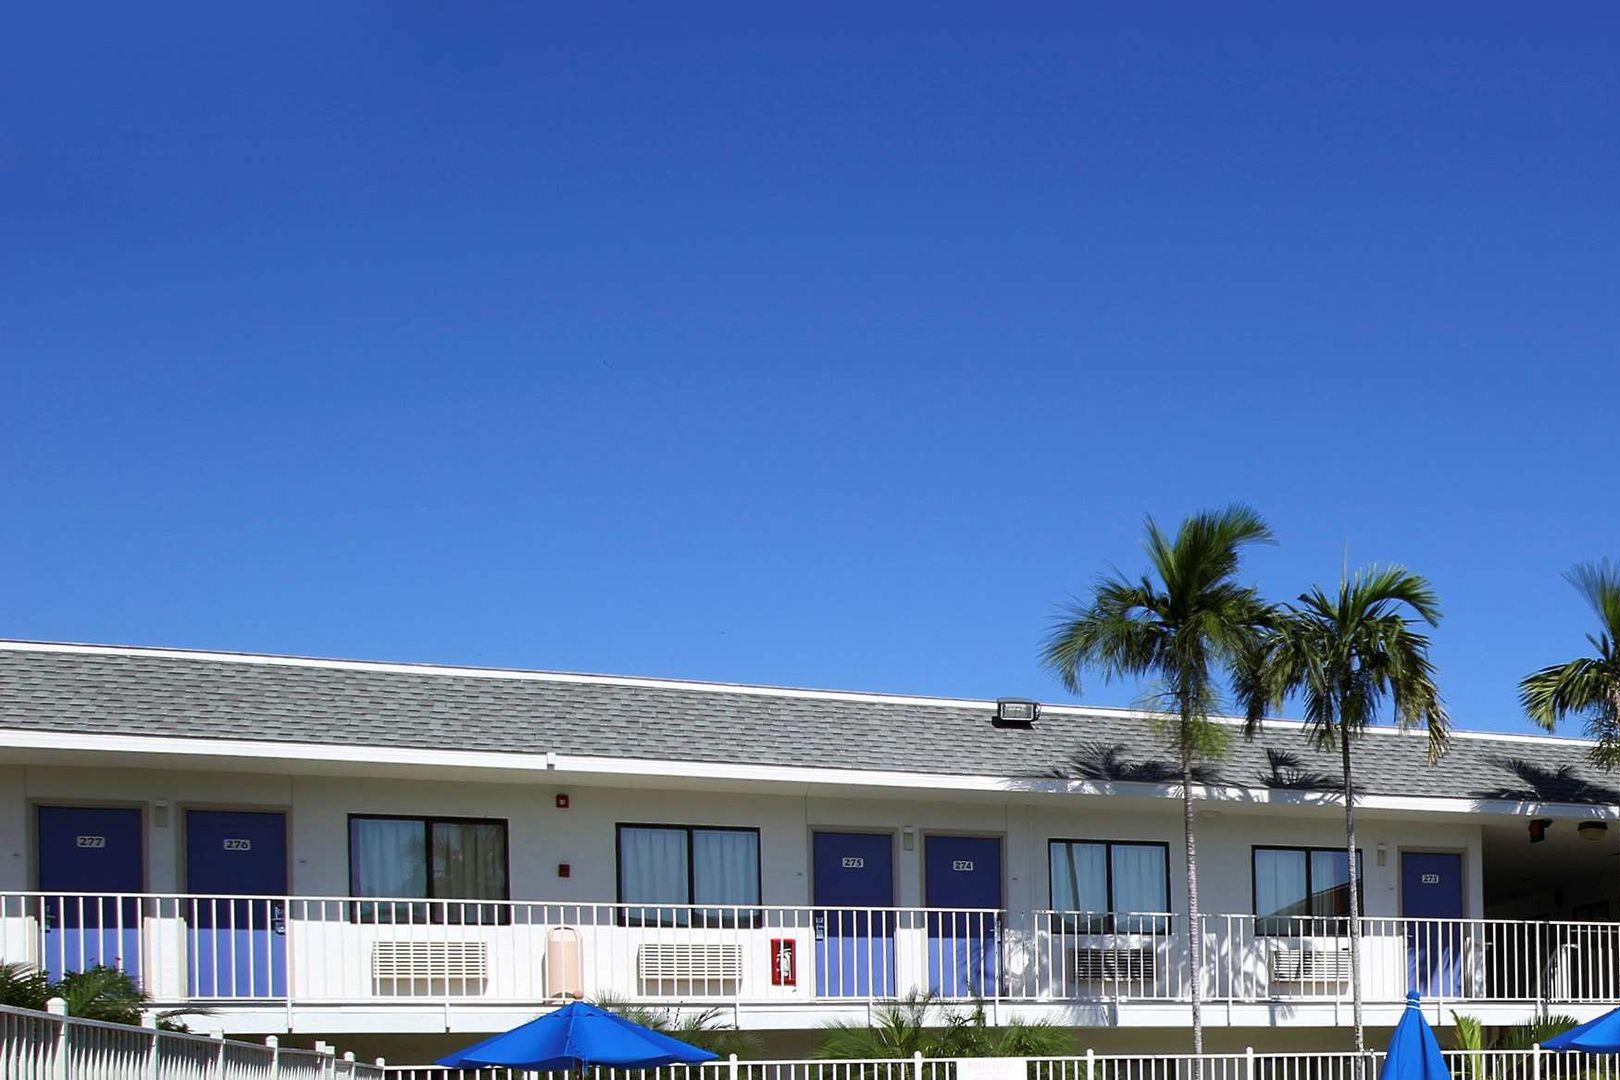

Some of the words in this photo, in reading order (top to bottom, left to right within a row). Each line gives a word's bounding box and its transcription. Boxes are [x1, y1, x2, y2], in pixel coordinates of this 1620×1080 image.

[79, 837, 103, 847] 277
[225, 840, 249, 850] 276
[844, 857, 863, 867] 275
[954, 861, 972, 870] 274
